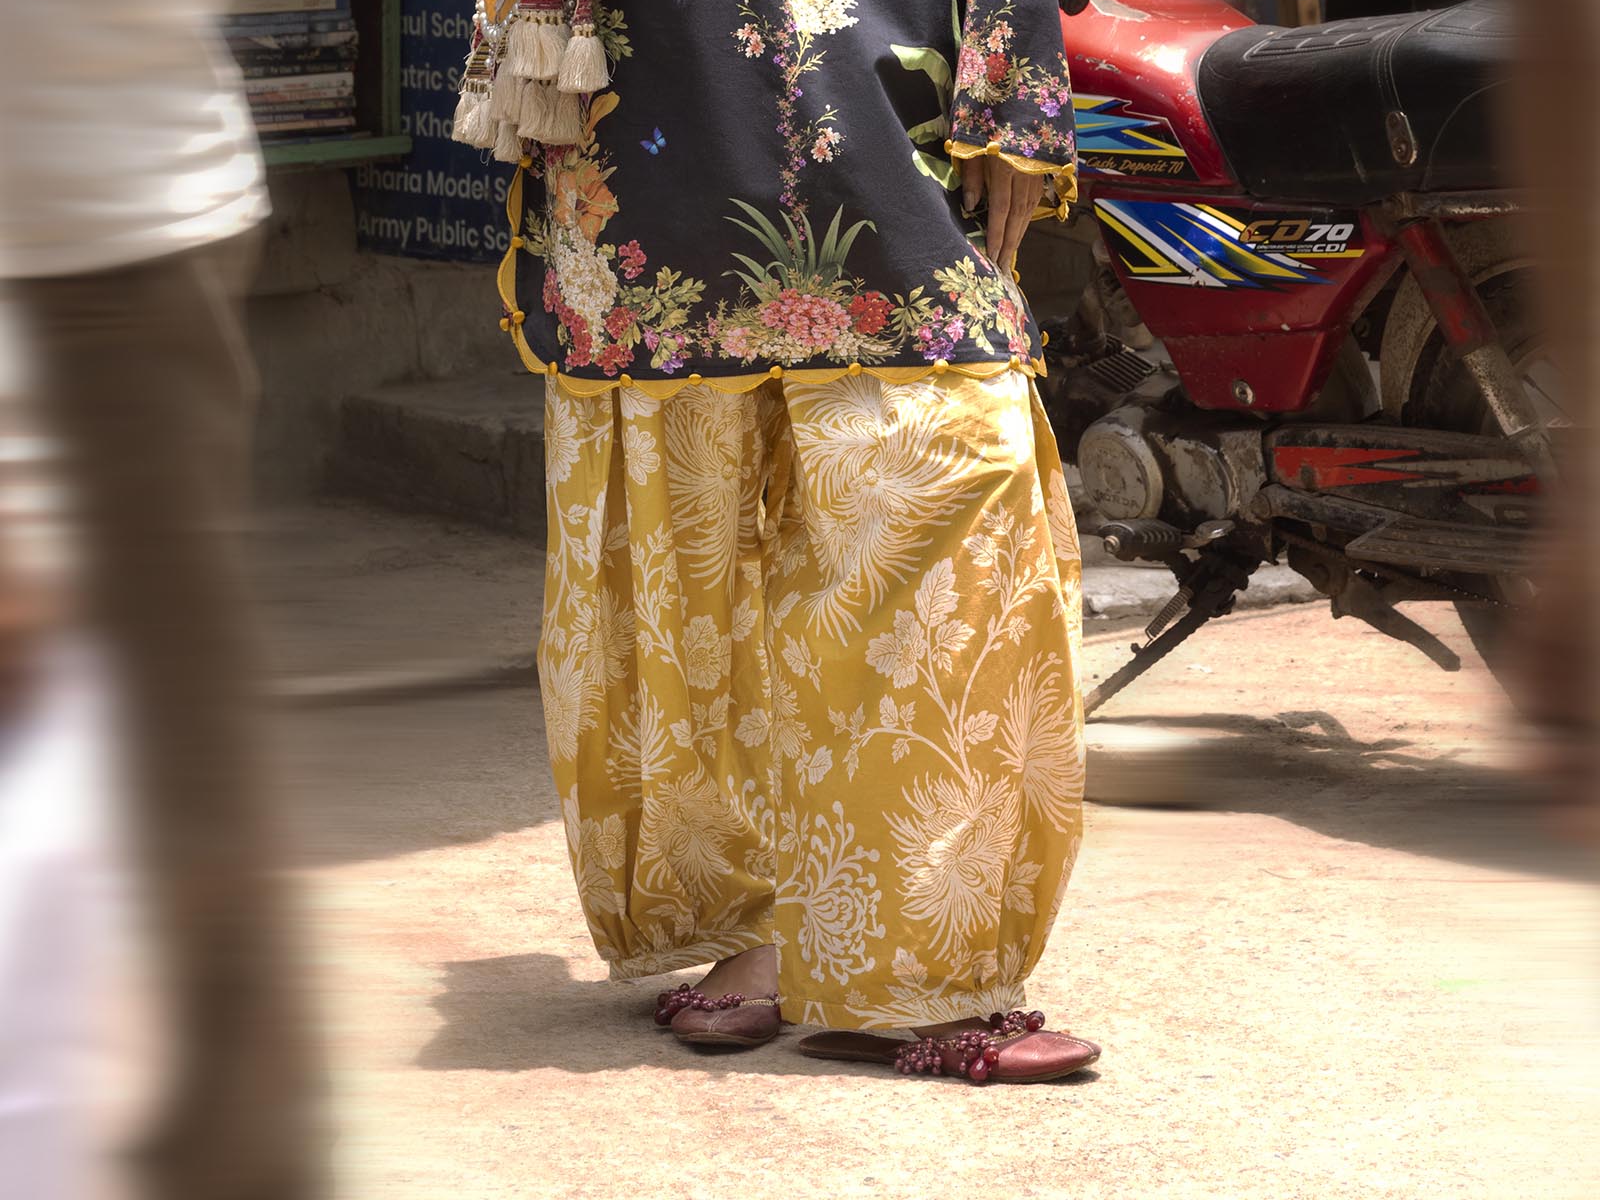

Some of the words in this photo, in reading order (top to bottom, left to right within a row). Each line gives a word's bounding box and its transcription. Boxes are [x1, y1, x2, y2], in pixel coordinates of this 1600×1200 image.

[1086, 156, 1117, 169] Cash
[1118, 158, 1168, 176] Deposit
[1167, 160, 1185, 175] 70
[426, 168, 490, 202] Model
[493, 177, 509, 203] S
[358, 210, 413, 250] Army
[415, 216, 480, 247] Public
[482, 224, 512, 251] Sc
[1311, 242, 1347, 253] CDI
